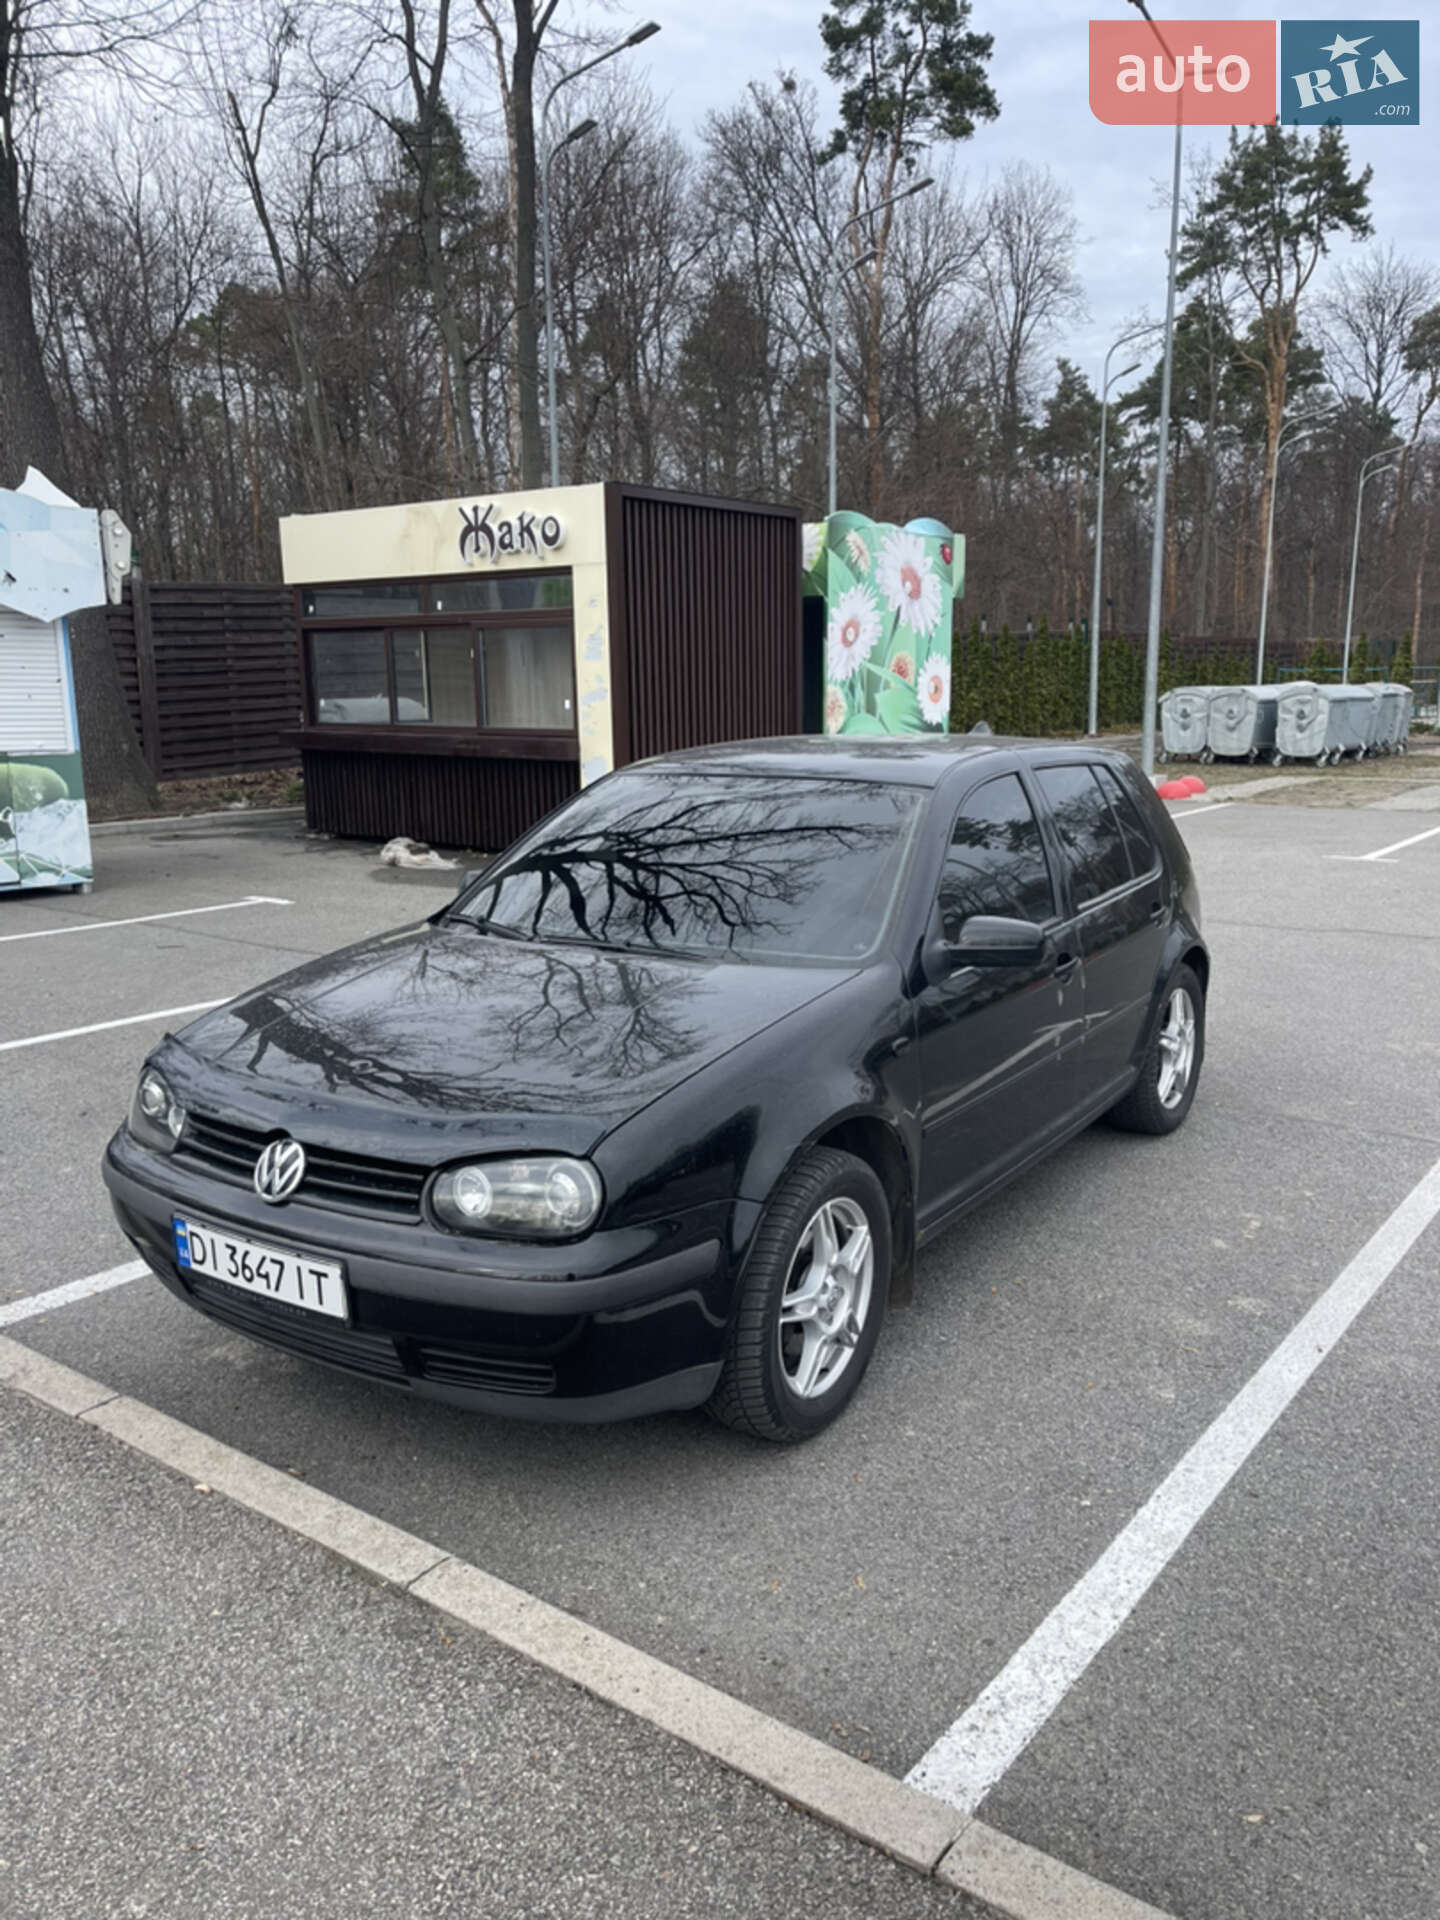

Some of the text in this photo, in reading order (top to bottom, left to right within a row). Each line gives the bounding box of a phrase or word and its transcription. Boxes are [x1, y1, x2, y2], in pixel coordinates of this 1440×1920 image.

[458, 503, 561, 561] Жако
[189, 1231, 218, 1272] DI
[224, 1242, 285, 1293] 3647
[296, 1265, 329, 1306] IT
